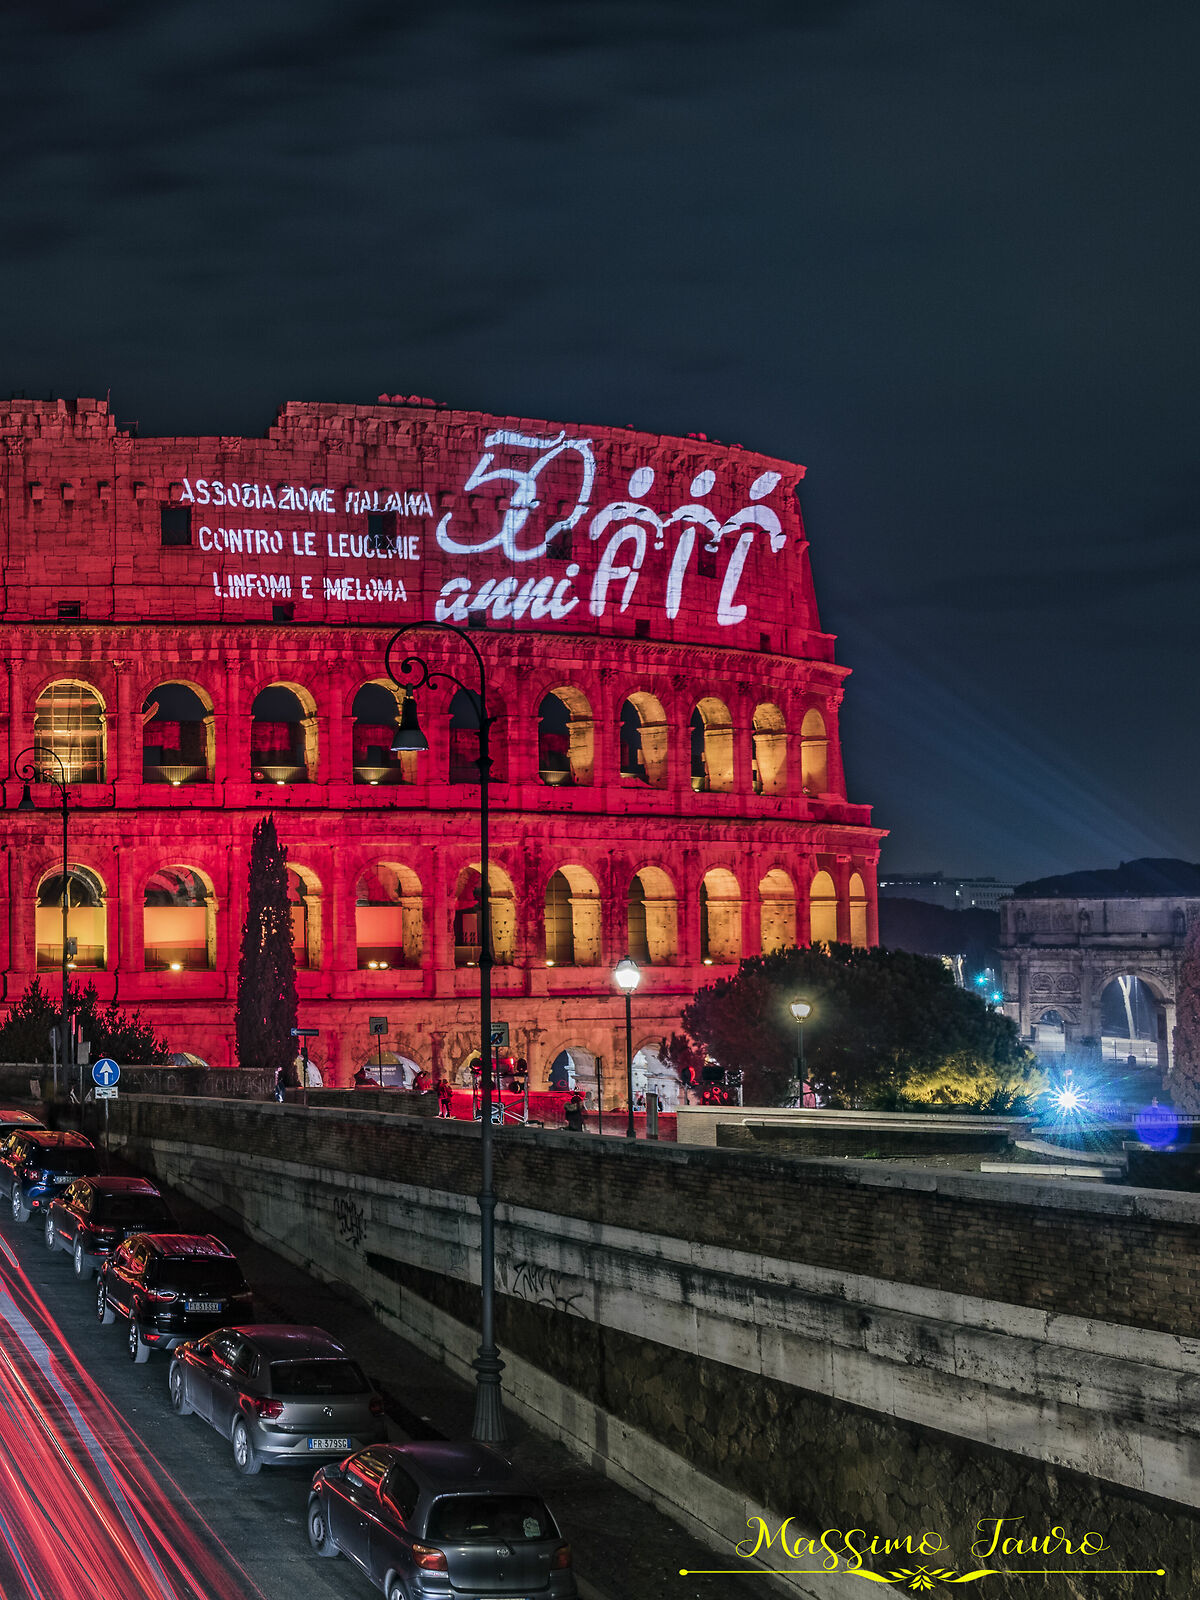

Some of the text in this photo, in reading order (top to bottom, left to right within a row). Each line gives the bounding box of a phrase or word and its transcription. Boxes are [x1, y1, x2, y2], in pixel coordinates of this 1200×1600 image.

[180, 478, 433, 517] ASSOCIAZIONE ITALIANA
[436, 430, 596, 562] 50
[199, 527, 419, 560] CONTRO LE LEUCEMIE
[213, 572, 291, 599] LINFOMI
[301, 576, 313, 599] E
[435, 564, 579, 622] anni
